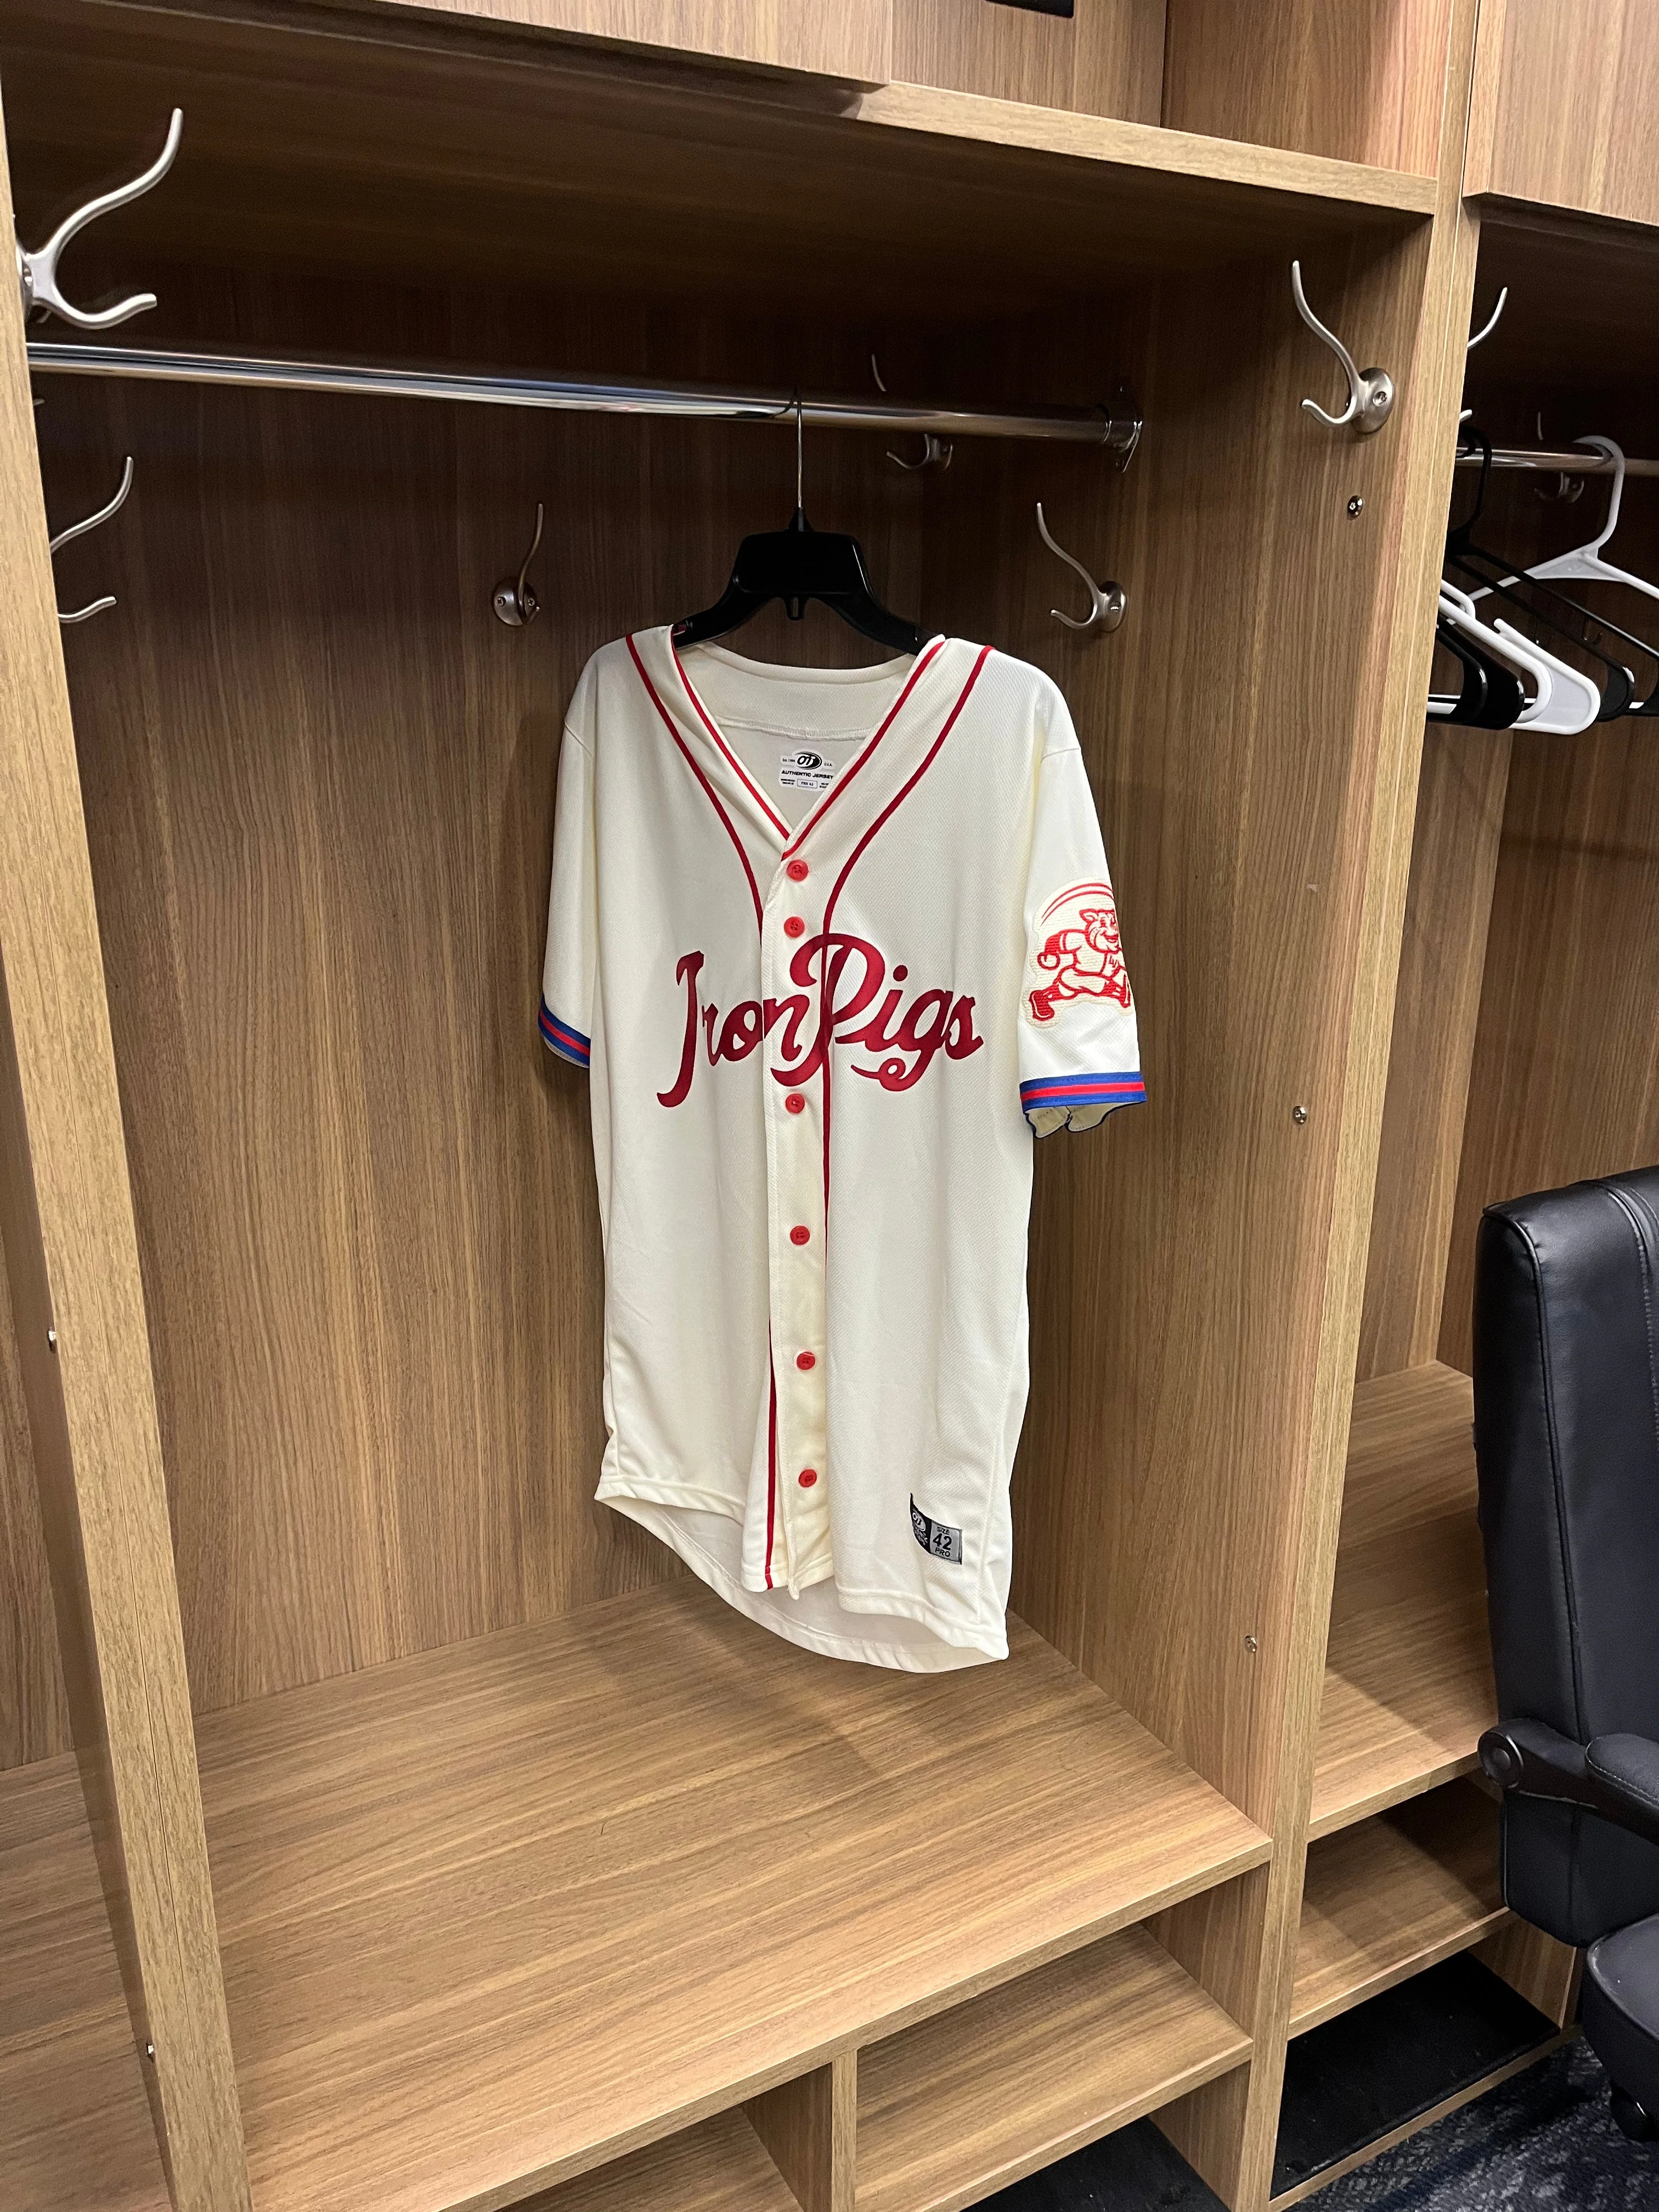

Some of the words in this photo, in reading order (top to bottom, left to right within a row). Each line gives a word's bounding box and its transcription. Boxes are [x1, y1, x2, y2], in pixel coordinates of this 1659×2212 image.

[937, 1526, 950, 1536] SIZE
[933, 1533, 952, 1551] 42
[935, 1547, 950, 1558] PRO
